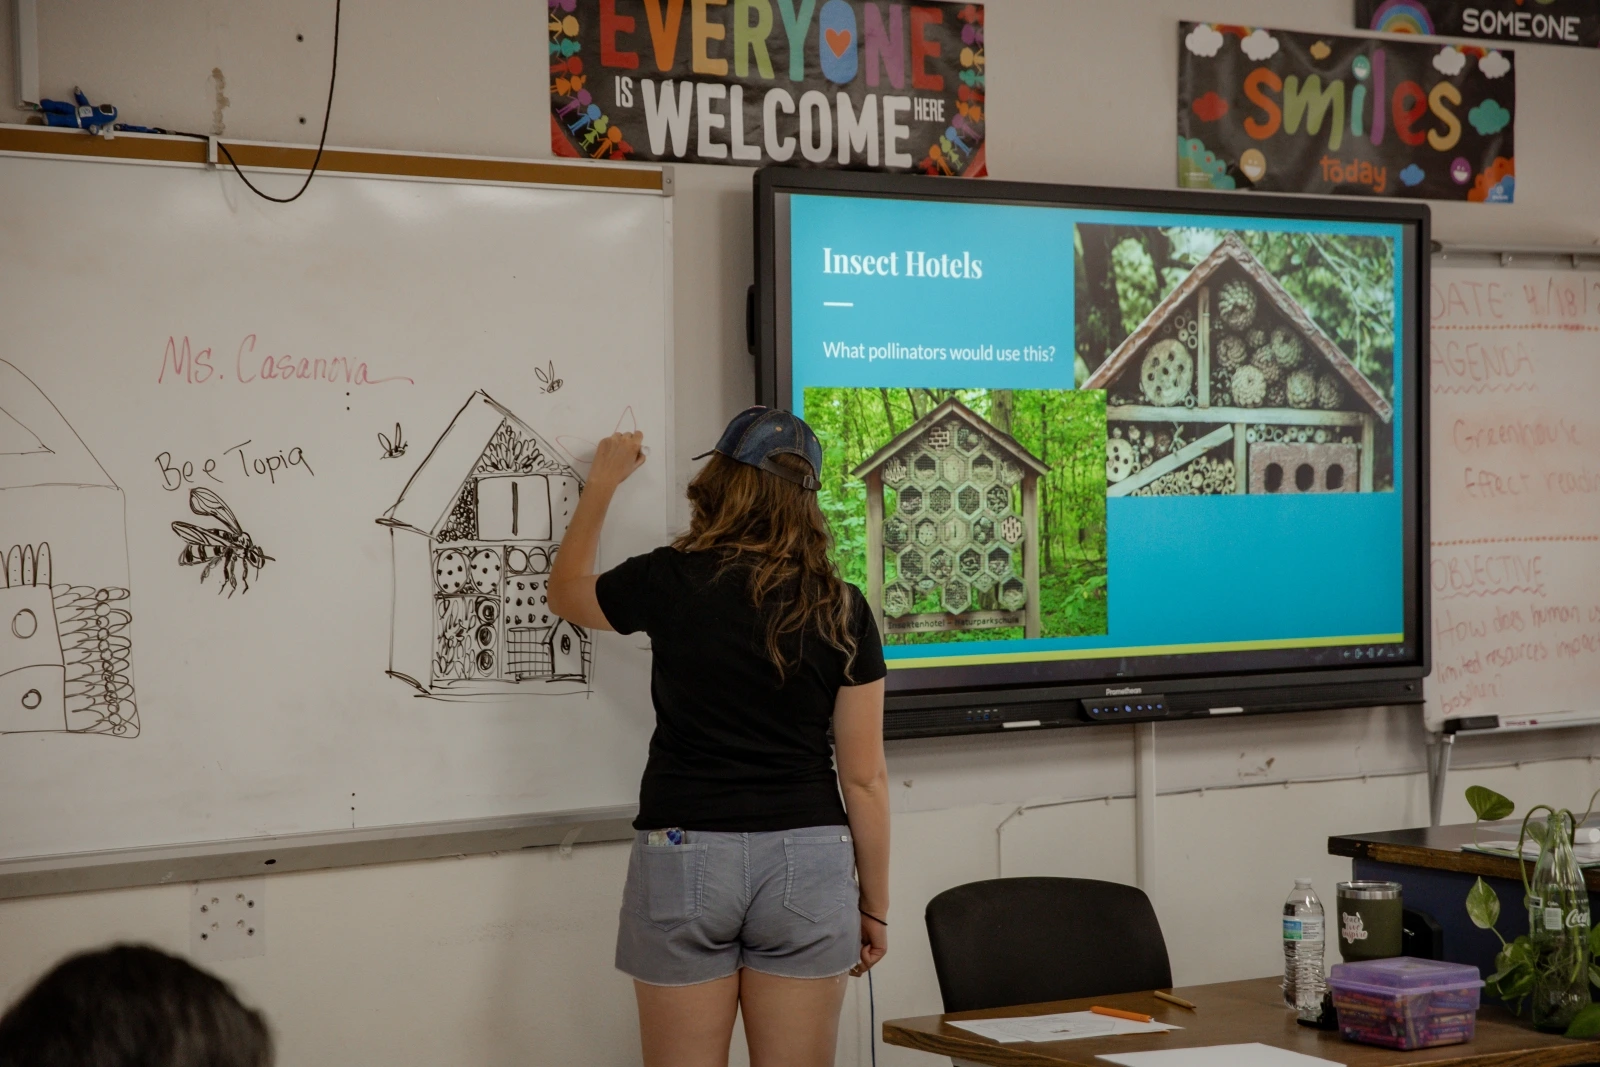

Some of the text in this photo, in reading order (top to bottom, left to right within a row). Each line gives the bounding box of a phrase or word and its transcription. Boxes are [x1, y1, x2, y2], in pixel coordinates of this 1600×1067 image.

[1462, 8, 1581, 41] SOMEONE
[601, 0, 944, 91] EVERYONE
[615, 75, 945, 168] IS WELCOME HERE
[1320, 155, 1388, 193] today
[823, 247, 983, 279] Insect Hotels
[158, 334, 414, 385] Ms. Casanova
[823, 341, 1056, 362] What pollinators would use this?
[1435, 609, 1486, 651] How
[1105, 687, 1142, 697] Promethean
